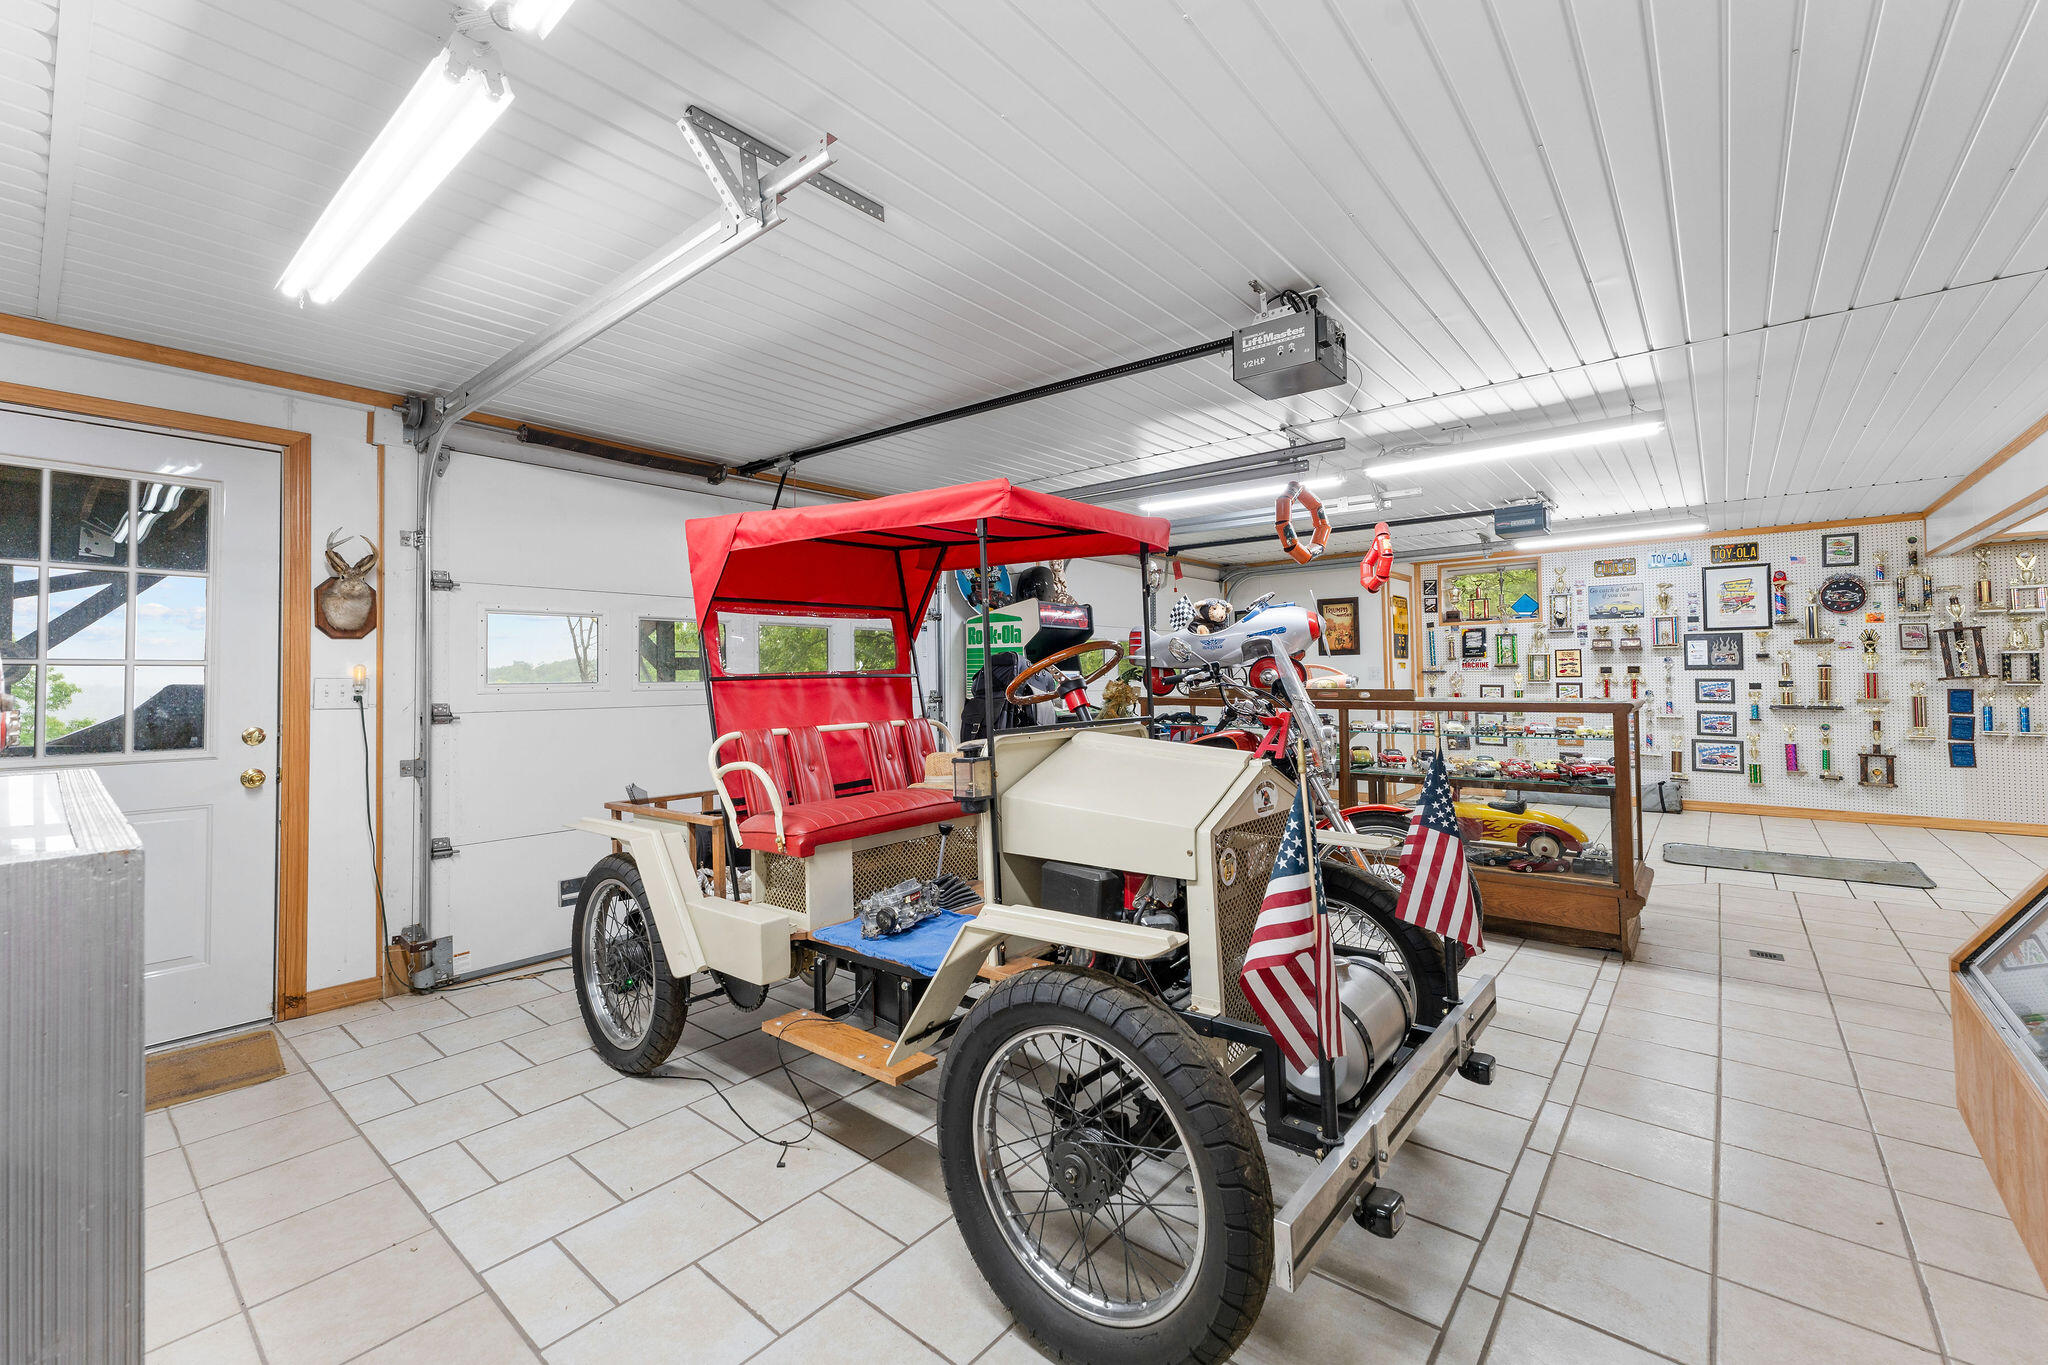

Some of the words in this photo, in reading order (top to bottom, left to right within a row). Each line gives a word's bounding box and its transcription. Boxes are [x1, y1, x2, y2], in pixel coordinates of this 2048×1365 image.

[1242, 326, 1305, 348] LiftMaster
[1651, 552, 1688, 564] TOY-OLA
[1713, 546, 1757, 559] TOY-OLA
[968, 625, 1022, 645] Rok-Ola
